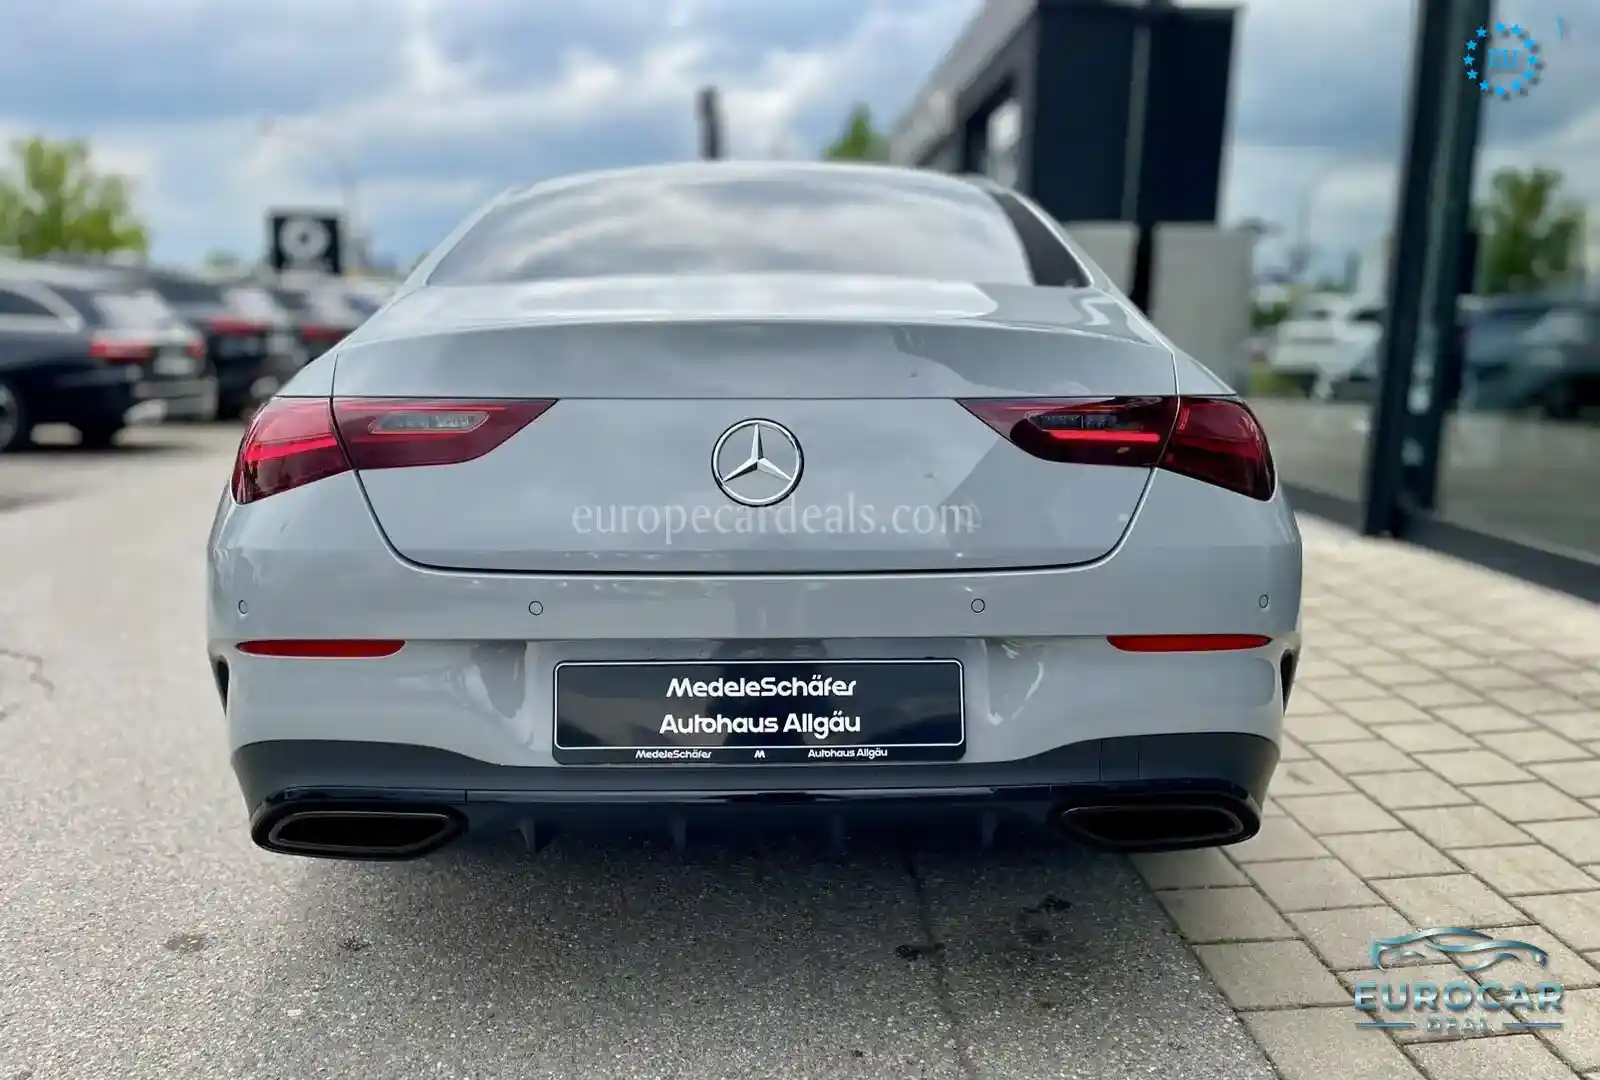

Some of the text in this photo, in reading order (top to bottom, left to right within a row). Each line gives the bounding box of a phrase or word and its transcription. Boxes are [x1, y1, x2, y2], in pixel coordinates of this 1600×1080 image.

[666, 674, 857, 698] MedeleSchäfer
[659, 710, 861, 740] Autohaus Allgäu
[635, 748, 712, 760] MedeleSchäfer
[807, 747, 889, 760] Autohaus Allgäu
